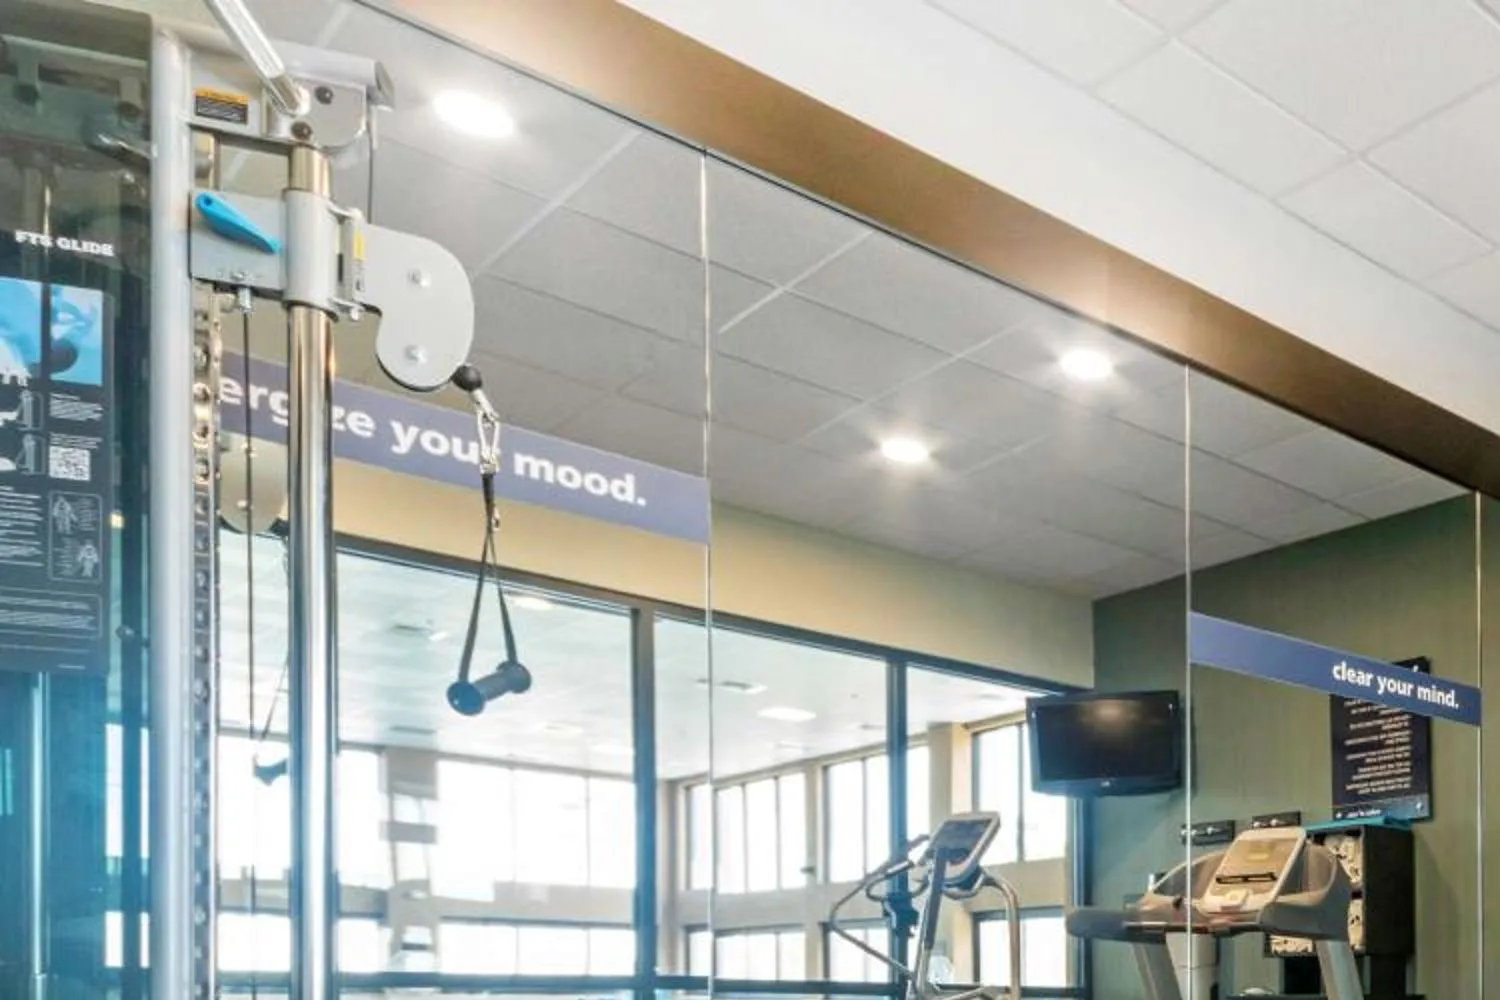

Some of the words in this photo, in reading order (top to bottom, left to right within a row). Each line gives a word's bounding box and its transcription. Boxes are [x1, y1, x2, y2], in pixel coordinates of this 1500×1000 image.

[56, 236, 114, 257] GLIDE
[219, 375, 376, 439] ergze
[391, 419, 499, 468] you
[513, 451, 648, 507] mood.
[1332, 660, 1373, 687] clear
[1376, 675, 1415, 695] your
[1417, 685, 1460, 710] mind.
